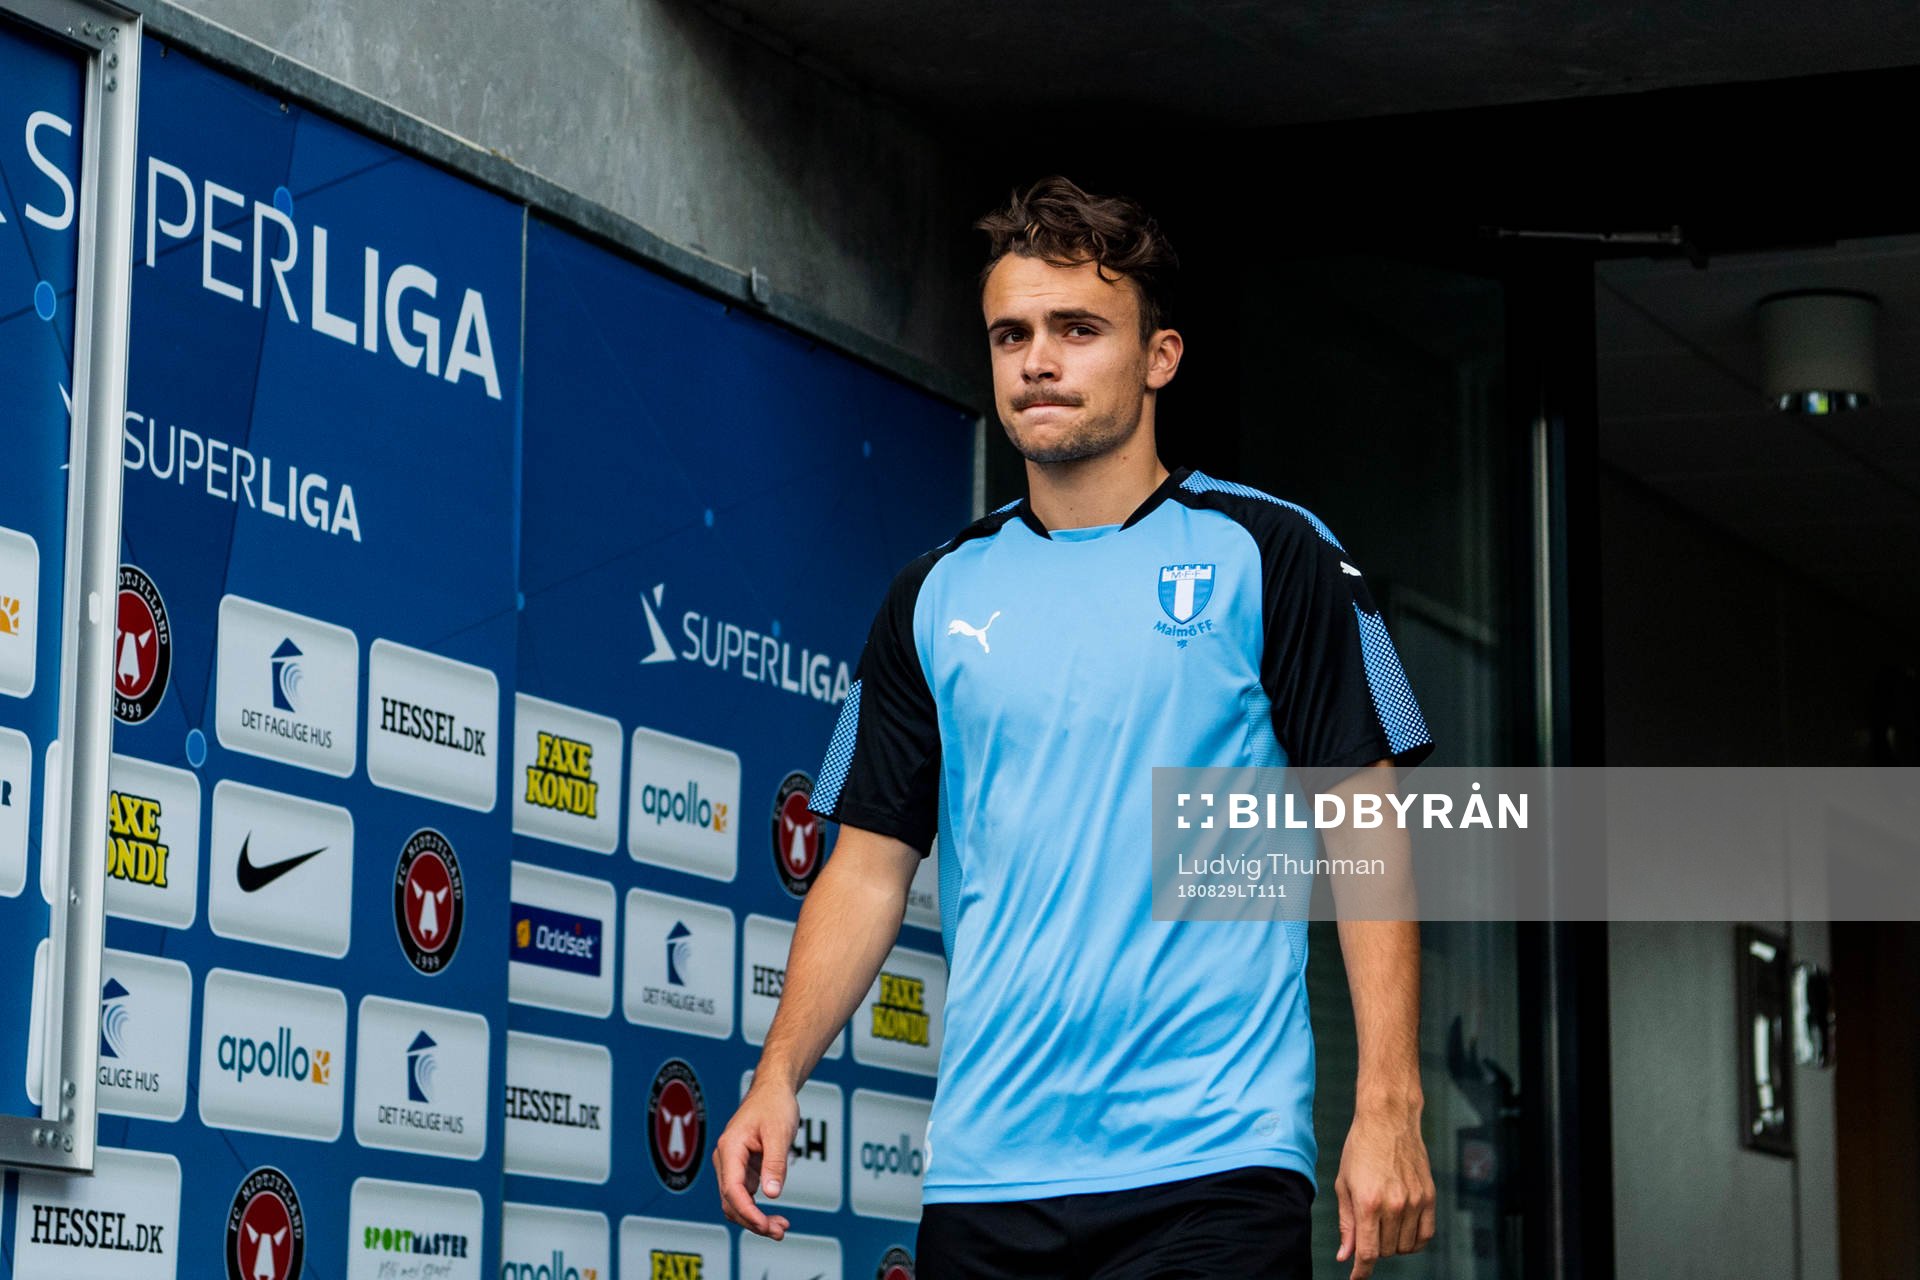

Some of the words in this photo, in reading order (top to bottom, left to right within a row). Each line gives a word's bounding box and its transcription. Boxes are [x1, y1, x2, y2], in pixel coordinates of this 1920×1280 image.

[25, 110, 502, 400] SPERLIGA
[124, 411, 362, 543] SUPERLIGA
[119, 571, 168, 645] DTJYLLAND
[1153, 620, 1197, 637] Malmö
[1197, 619, 1213, 634] FF
[682, 611, 850, 704] SUPERLIGA
[241, 708, 262, 730] DET
[264, 715, 308, 743] FAGLIGE
[310, 727, 332, 749] HUS
[380, 697, 486, 756] HESSEL.DK
[537, 731, 592, 778] FAXE
[109, 790, 162, 842] AXE
[525, 767, 598, 819] KONDI
[642, 780, 711, 829] apollo
[535, 924, 593, 959] Oddset
[98, 1065, 133, 1089] GLIGE
[135, 1071, 160, 1092] HUS
[217, 1026, 309, 1083] apollo
[378, 1104, 398, 1125] DET
[443, 1114, 464, 1135] HUS
[505, 1085, 601, 1131] HESSEL.DK
[861, 1133, 924, 1180] apollo
[31, 1204, 164, 1254] HESSEL.DK
[364, 1226, 468, 1258] SPORTMASTER
